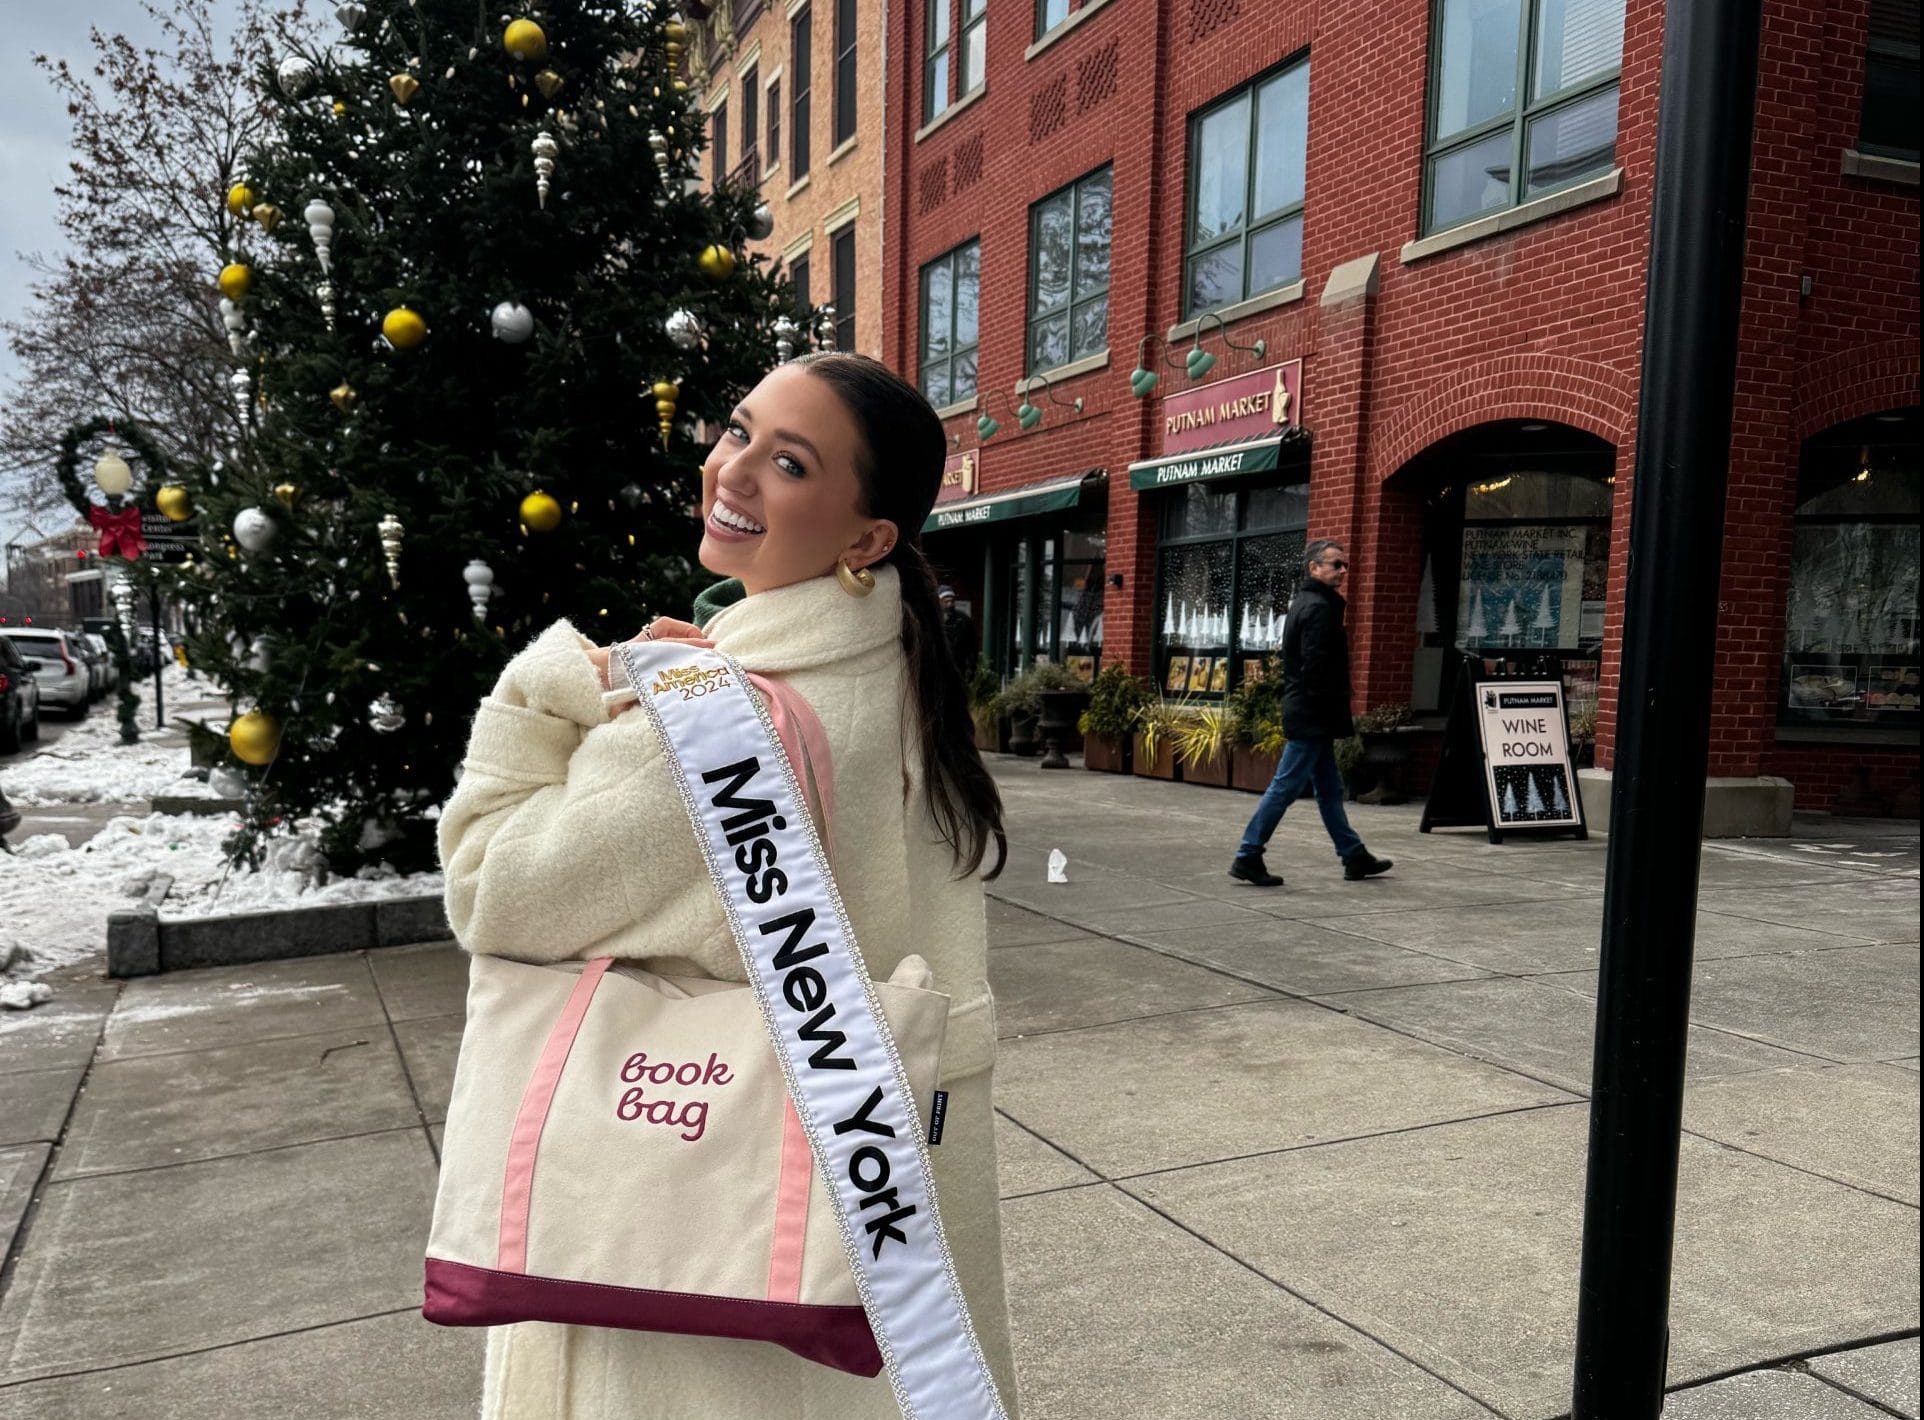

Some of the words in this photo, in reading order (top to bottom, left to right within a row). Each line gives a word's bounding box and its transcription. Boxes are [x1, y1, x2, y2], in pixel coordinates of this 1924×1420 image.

[1166, 405, 1215, 435] PUTNAM
[1220, 391, 1270, 421] MARKET
[1157, 460, 1198, 483] PUTNAM
[1201, 453, 1244, 476] MARKET
[938, 511, 963, 526] PUTNAM
[964, 506, 991, 522] MARKET
[1465, 529, 1509, 540] PUTNAM
[1512, 528, 1554, 539] MARKET
[147, 542, 185, 553] ongress
[1511, 540, 1539, 550] WINE
[653, 667, 730, 695] America
[657, 665, 700, 681] Miss
[679, 676, 731, 701] 2024
[1503, 697, 1529, 705] PUTNAM
[1530, 696, 1553, 704] MARKET
[1502, 719, 1547, 734] WINE
[1502, 742, 1553, 757] ROOM
[701, 756, 788, 904] Miss
[758, 908, 858, 1071] New
[833, 1085, 917, 1262] York
[620, 1052, 734, 1086] book
[616, 1087, 709, 1142] bag
